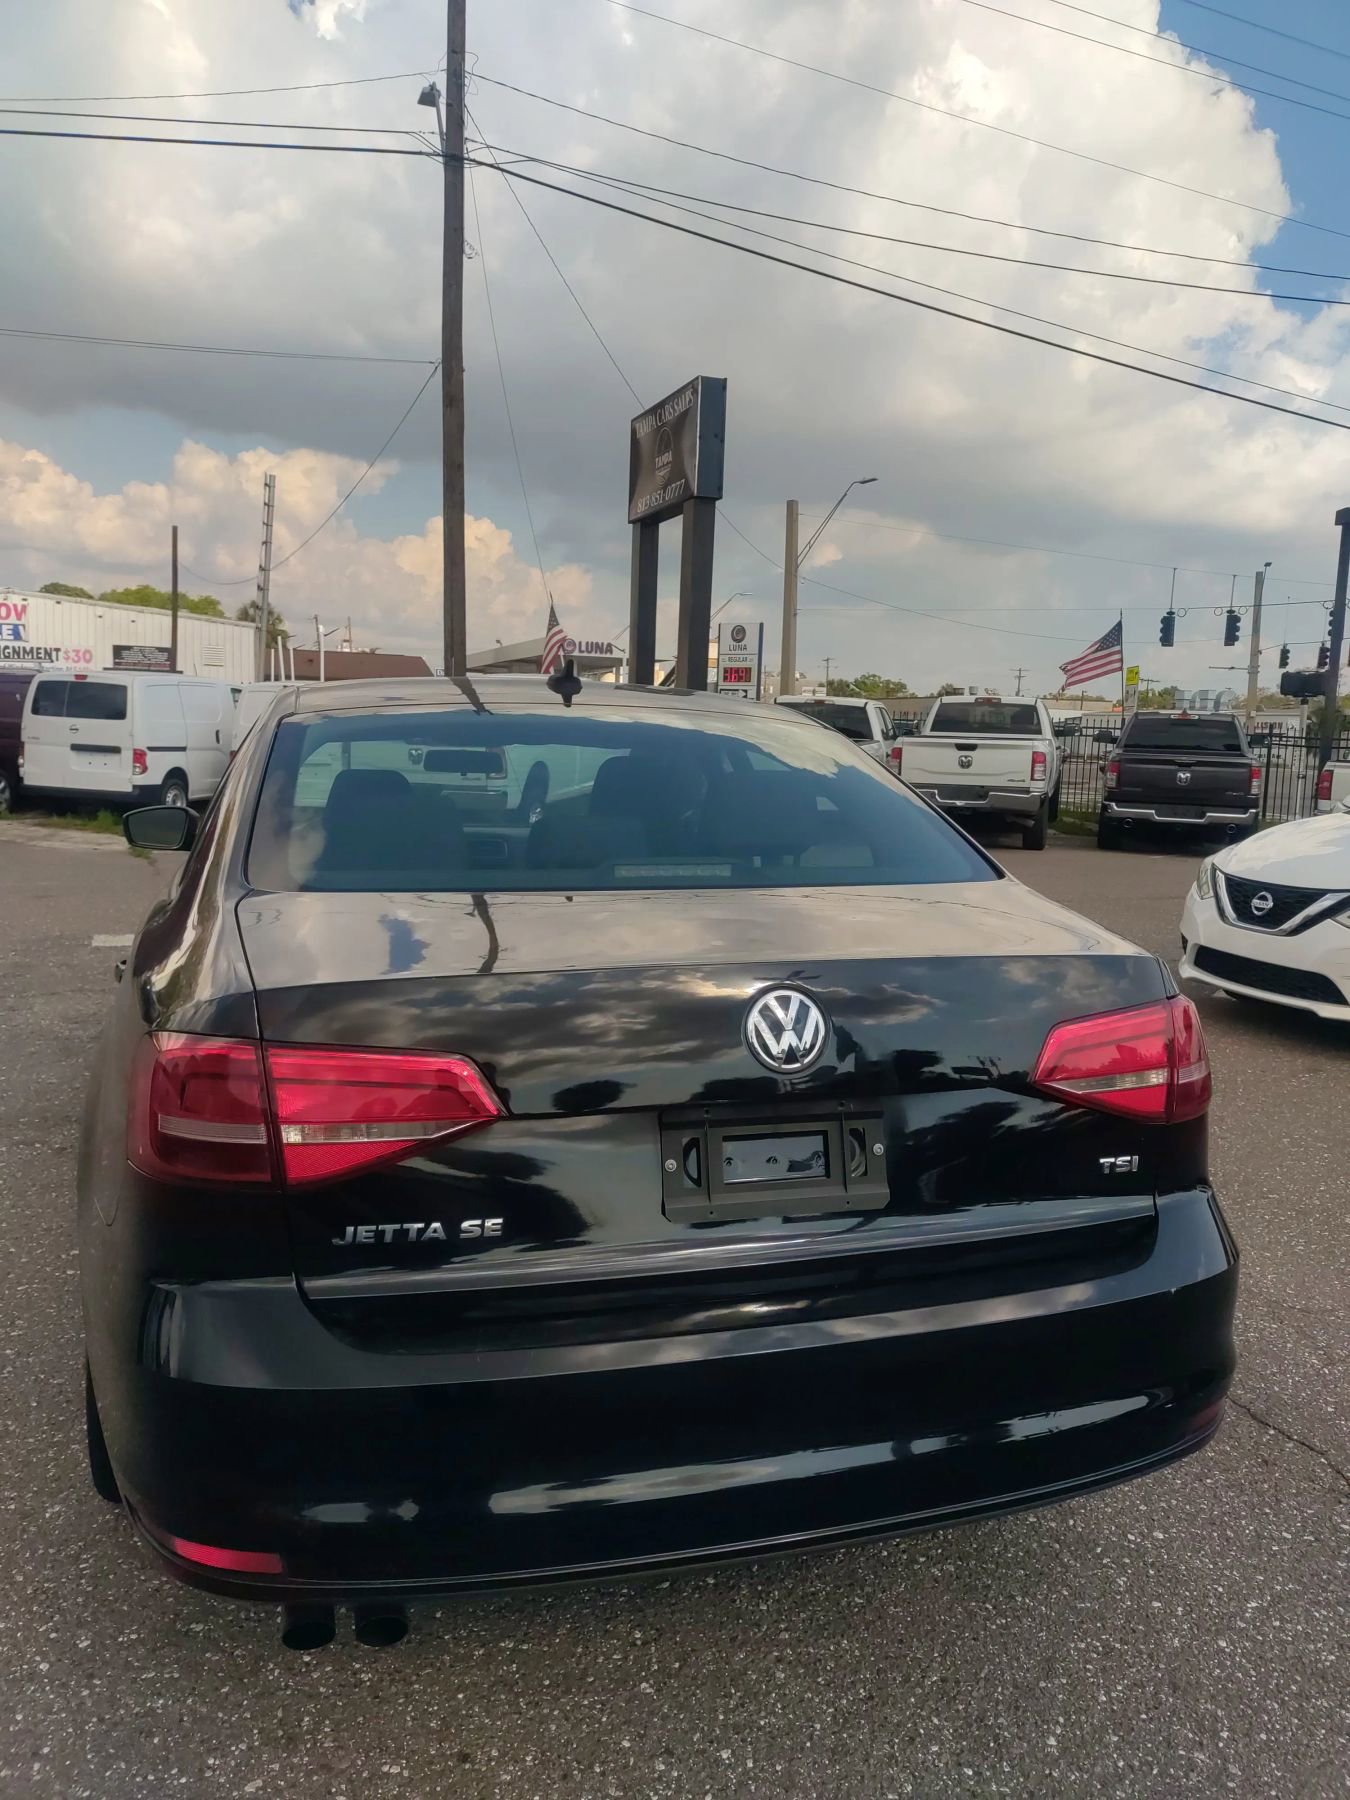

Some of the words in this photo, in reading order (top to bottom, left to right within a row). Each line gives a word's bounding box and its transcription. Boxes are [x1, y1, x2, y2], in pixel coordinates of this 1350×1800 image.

[635, 413, 657, 438] TAMPA
[656, 402, 674, 426] CARS
[673, 388, 694, 416] SALES
[0, 645, 61, 661] GNMENT
[63, 648, 93, 664] $30
[578, 641, 613, 656] LUNA
[728, 644, 748, 652] LUNA
[1099, 1155, 1139, 1174] TSI
[331, 1221, 448, 1246] JETTA
[459, 1217, 504, 1239] SE
